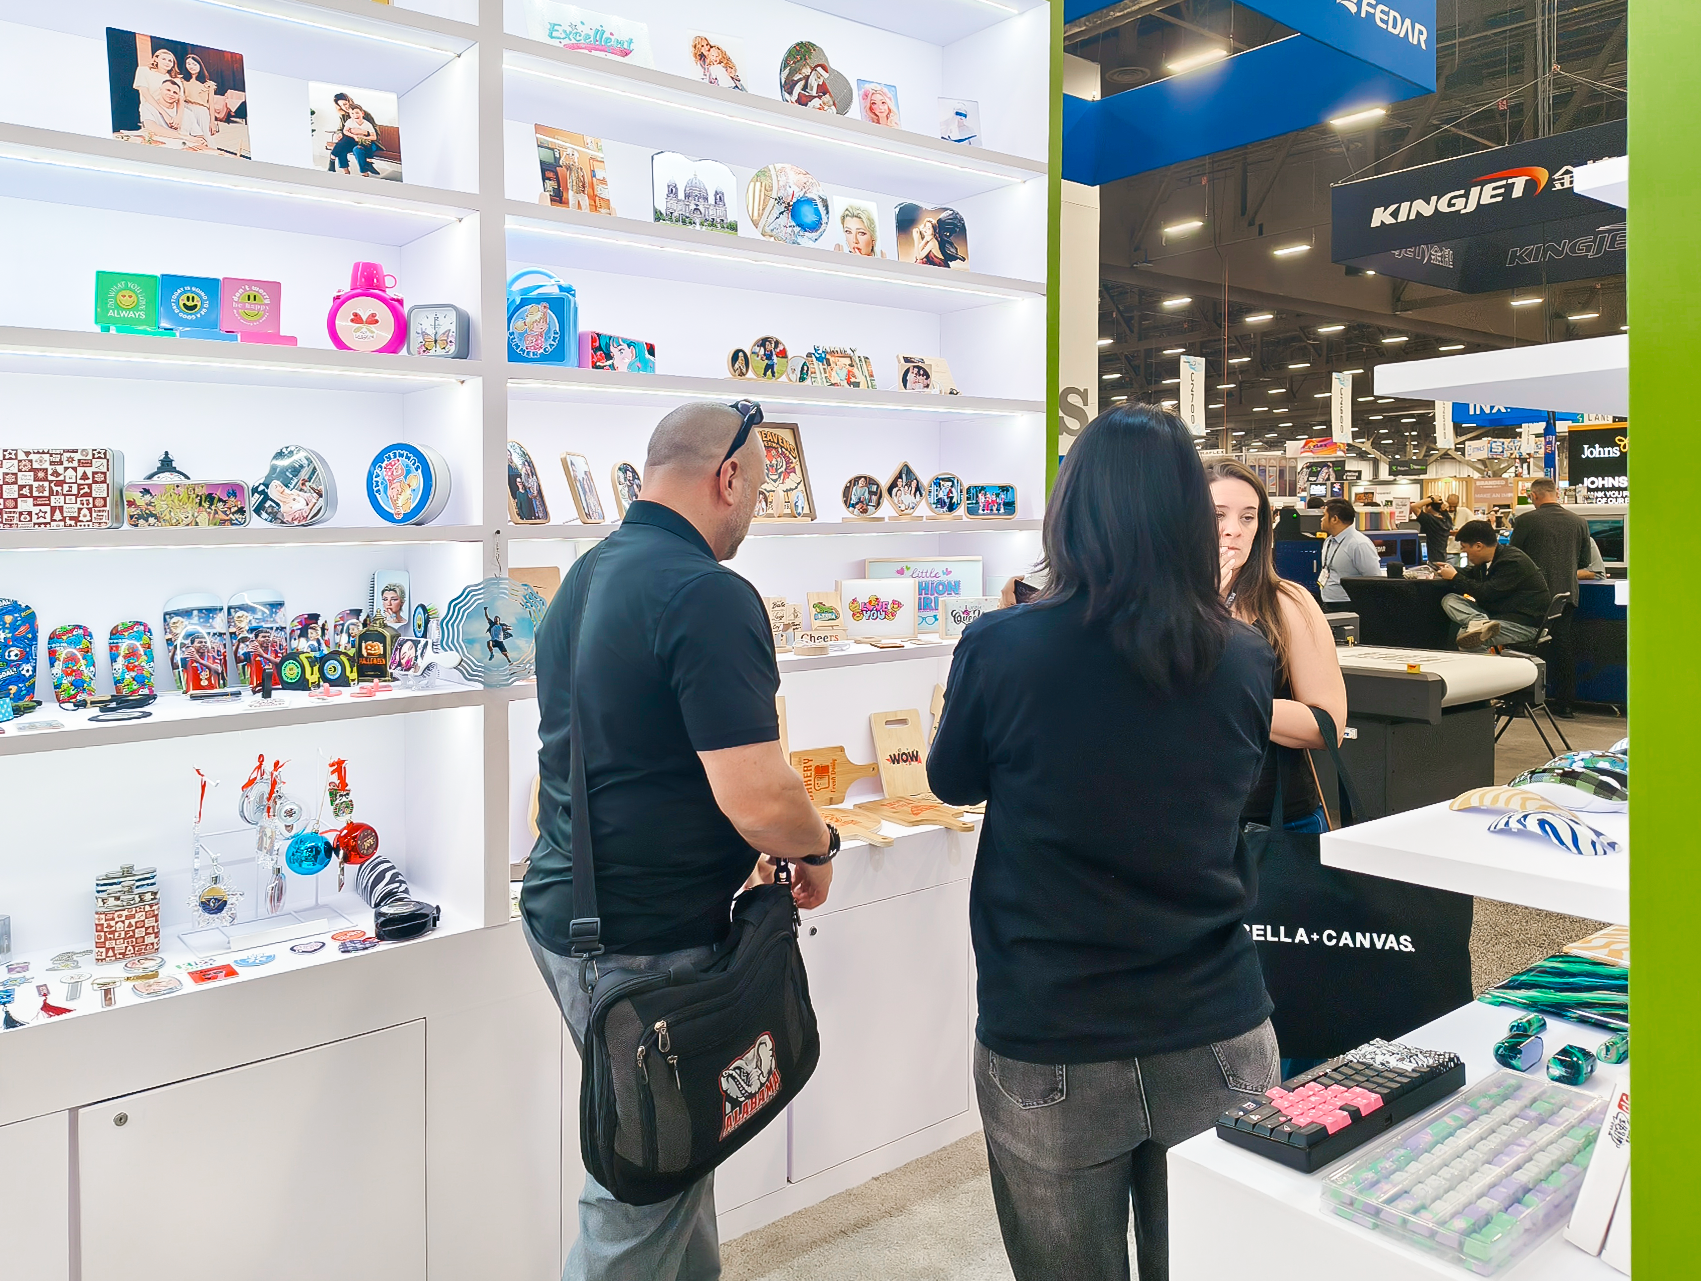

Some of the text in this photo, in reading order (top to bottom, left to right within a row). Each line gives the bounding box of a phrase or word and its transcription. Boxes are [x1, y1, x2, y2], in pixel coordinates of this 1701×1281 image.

[547, 22, 635, 52] Excellent
[1361, 0, 1428, 51] FEDAR
[1369, 174, 1532, 229] KINGJET
[1506, 230, 1628, 268] KINGJE
[107, 309, 146, 319] ALWAYS
[507, 328, 561, 358] SUMMER CAMP
[384, 449, 422, 473] SUMMER
[910, 567, 941, 579] little
[862, 610, 886, 621] YOU
[801, 632, 839, 644] Cheers
[889, 750, 920, 766] WOW
[724, 1069, 781, 1133] ALABAMA
